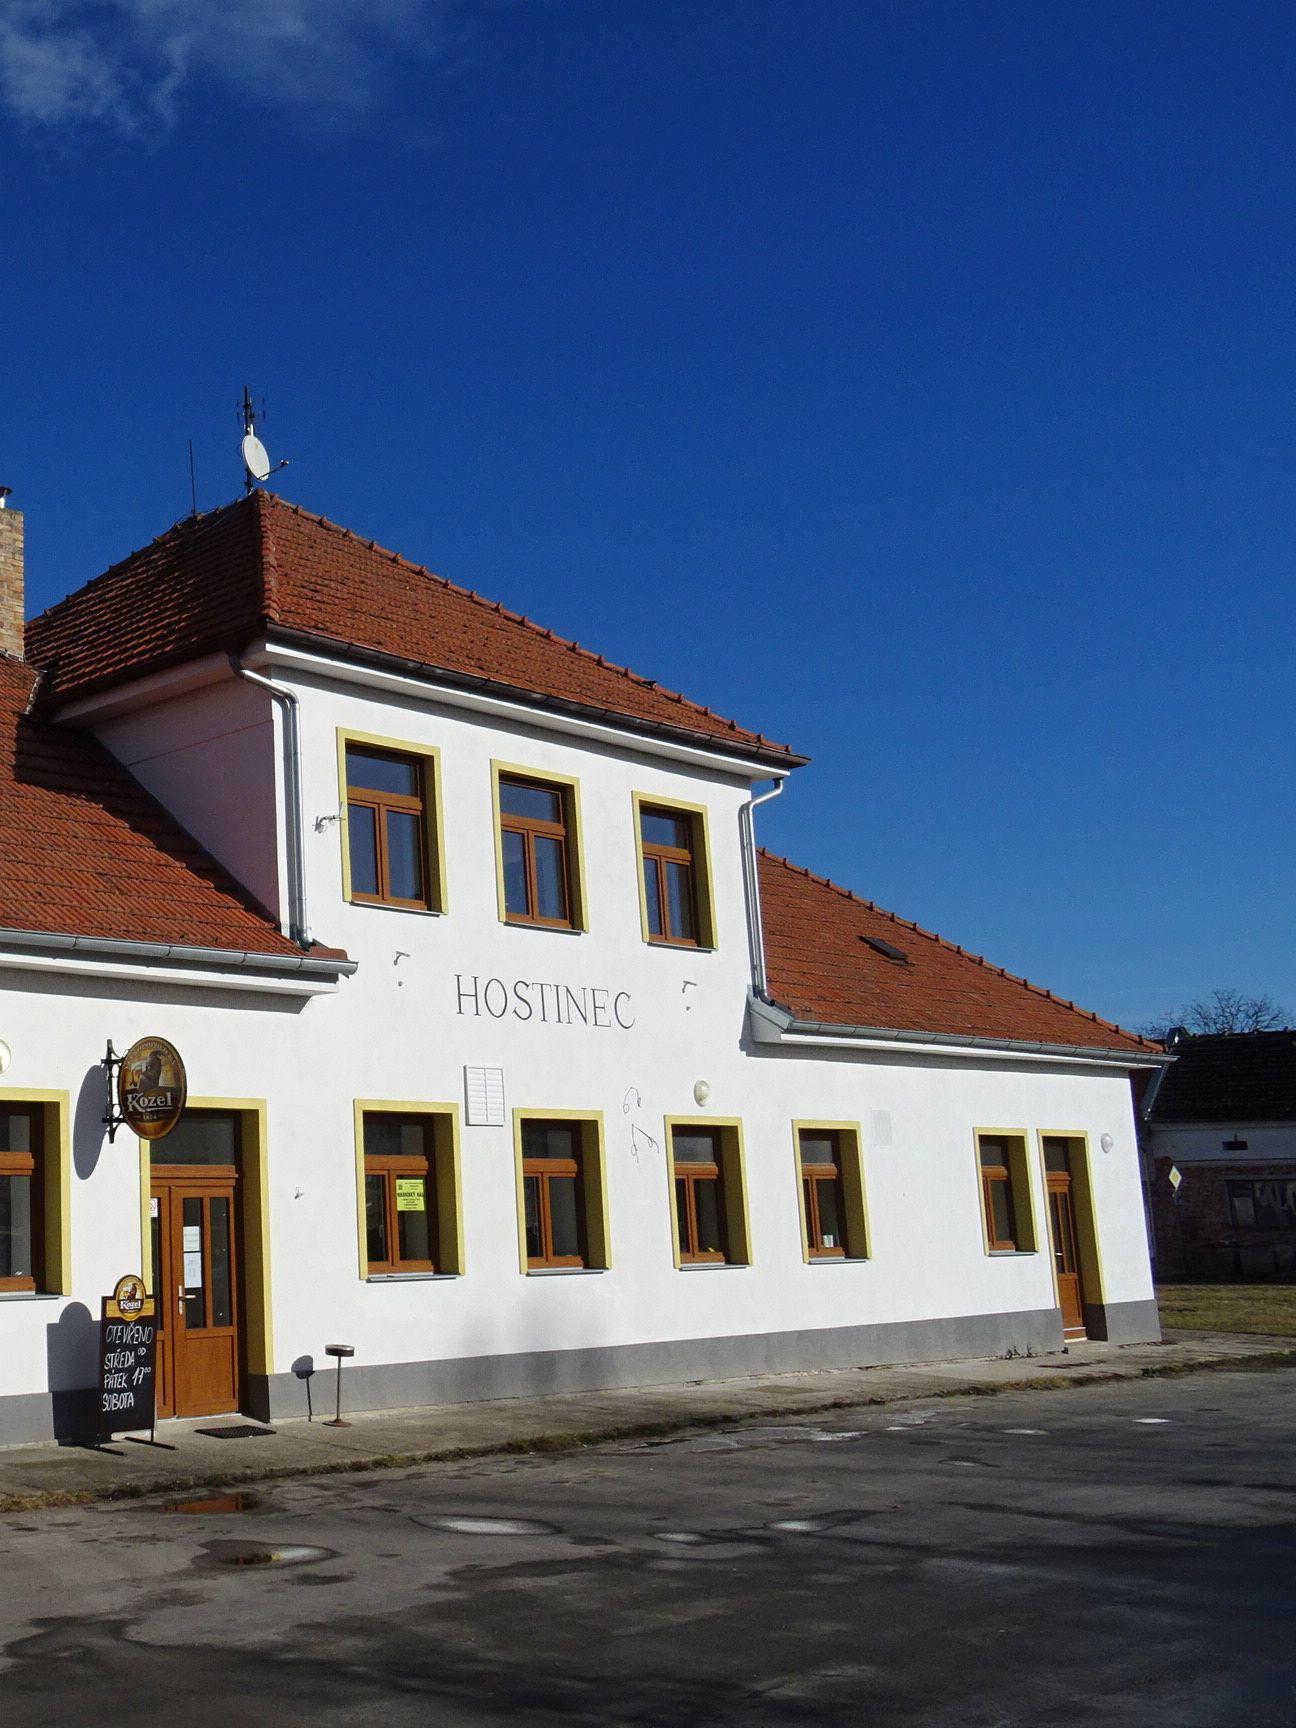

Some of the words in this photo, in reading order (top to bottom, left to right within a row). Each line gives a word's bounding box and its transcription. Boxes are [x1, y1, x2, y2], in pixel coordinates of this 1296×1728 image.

[454, 974, 636, 1030] HOSTINEC
[126, 1091, 173, 1113] Kozel
[120, 1300, 141, 1310] Kozel
[106, 1322, 154, 1344] OTEVŘENO
[104, 1348, 135, 1370] STŘEDA
[104, 1369, 128, 1389] PÁTEK
[102, 1391, 135, 1412] SOBOTA
